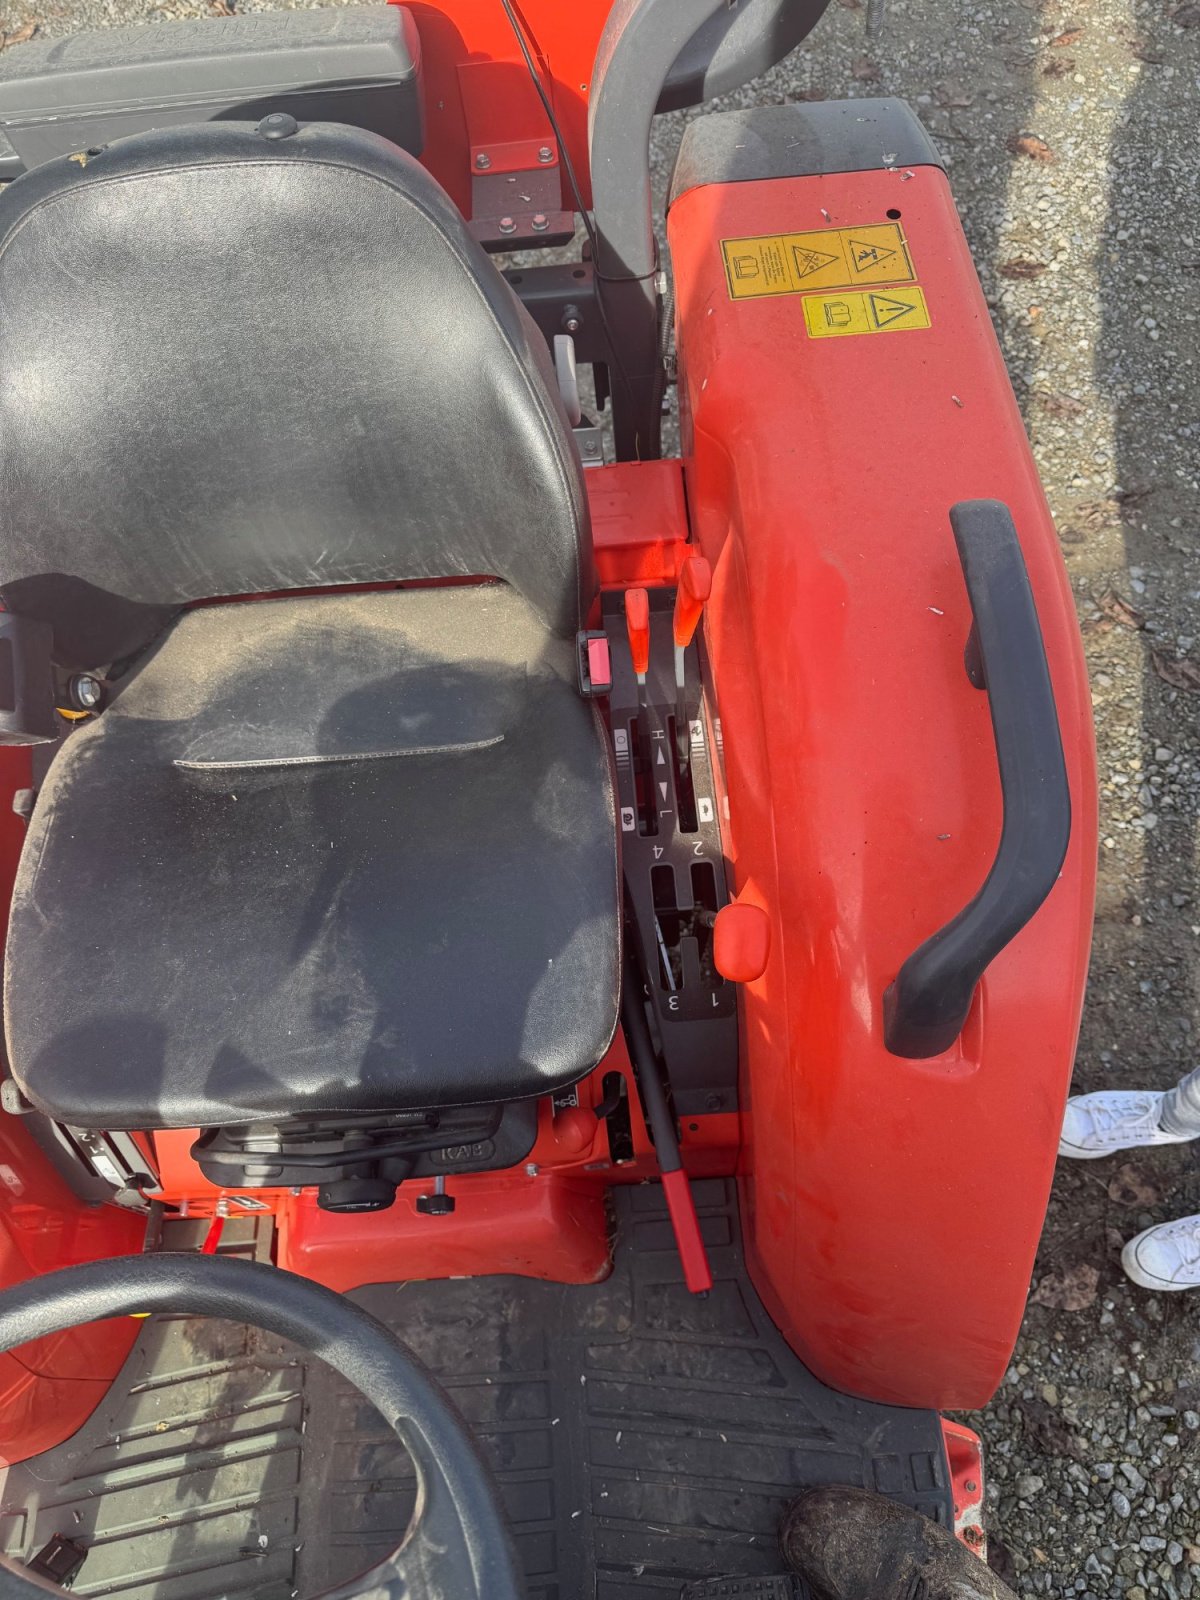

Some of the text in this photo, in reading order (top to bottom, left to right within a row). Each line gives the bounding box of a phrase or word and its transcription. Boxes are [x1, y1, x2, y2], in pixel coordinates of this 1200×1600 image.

[651, 729, 665, 739] H
[659, 809, 673, 818] L
[652, 845, 664, 859] 4
[692, 841, 704, 856] 2
[668, 995, 679, 1011] 3
[711, 992, 719, 1007] 1
[78, 1133, 91, 1142] 2
[441, 1143, 483, 1160] KAB
